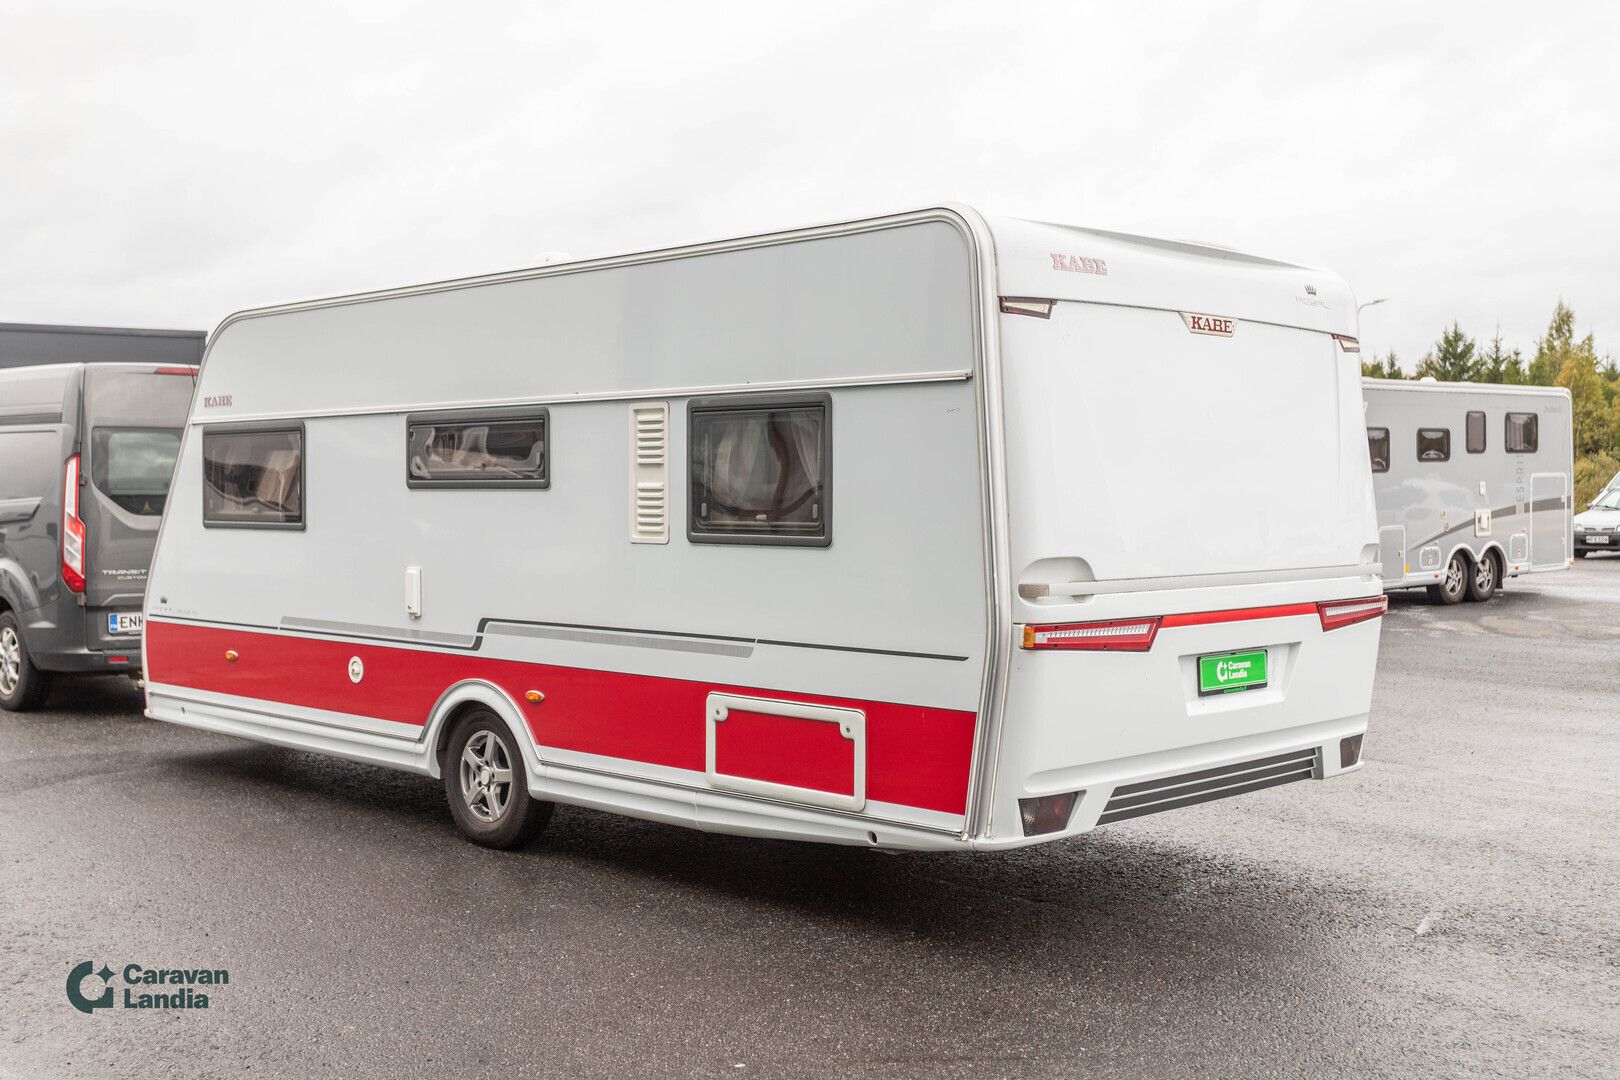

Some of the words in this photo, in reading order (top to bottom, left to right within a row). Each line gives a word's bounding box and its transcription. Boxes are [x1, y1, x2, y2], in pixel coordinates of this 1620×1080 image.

[1050, 253, 1108, 276] KABE
[1191, 315, 1233, 334] KABE
[1228, 669, 1248, 680] Landia
